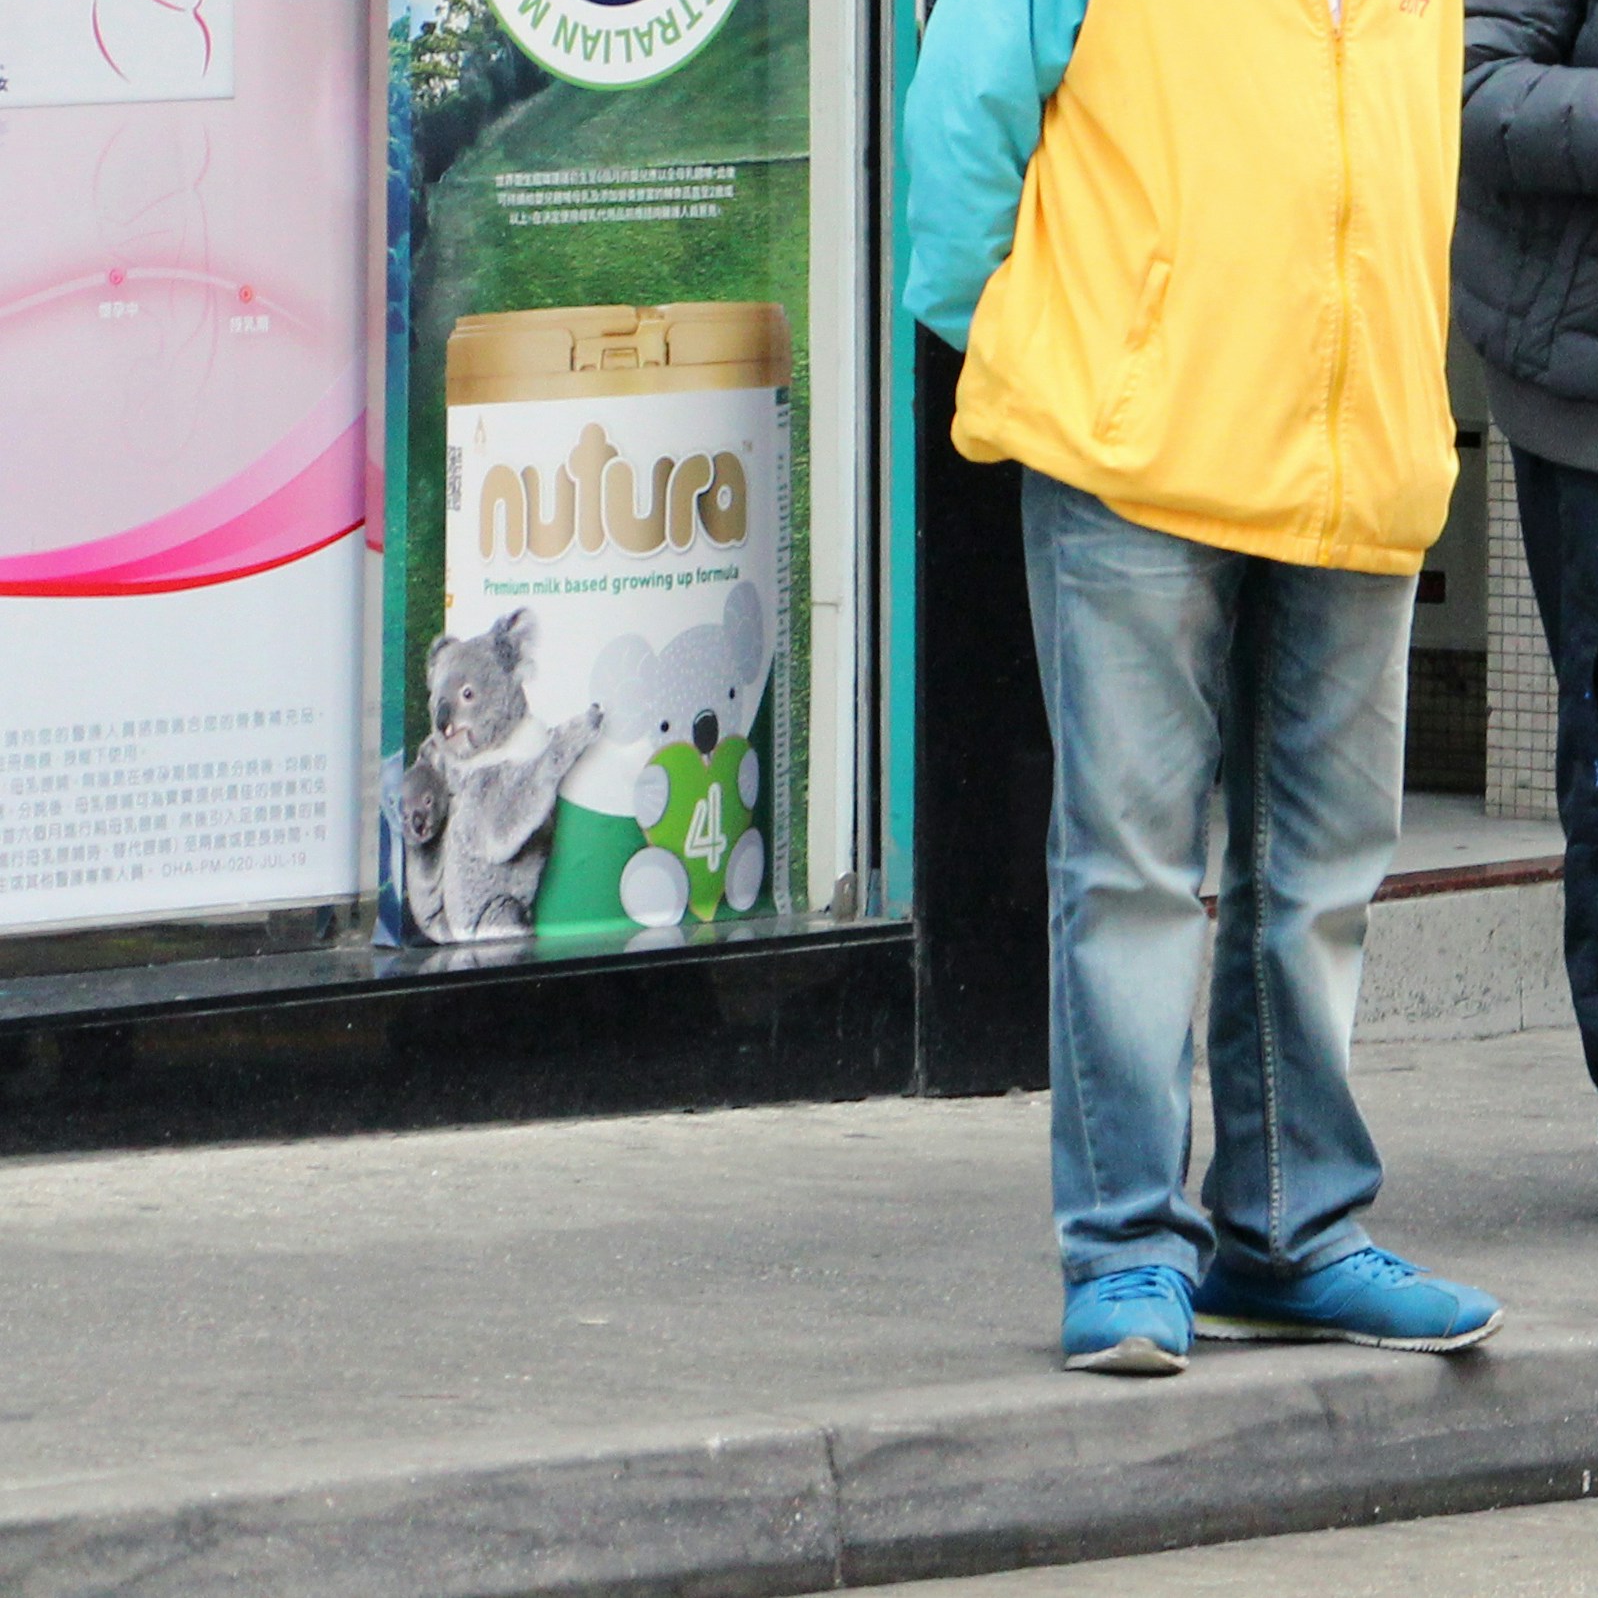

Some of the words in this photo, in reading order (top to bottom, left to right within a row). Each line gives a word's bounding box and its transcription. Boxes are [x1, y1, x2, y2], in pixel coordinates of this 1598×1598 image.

[478, 422, 750, 562] nutura
[484, 578, 529, 595] Premium
[533, 580, 560, 594] milk
[564, 576, 607, 593] based
[612, 570, 673, 594] growing
[677, 572, 692, 586] up
[695, 564, 739, 582] formula
[684, 781, 726, 873] 4
